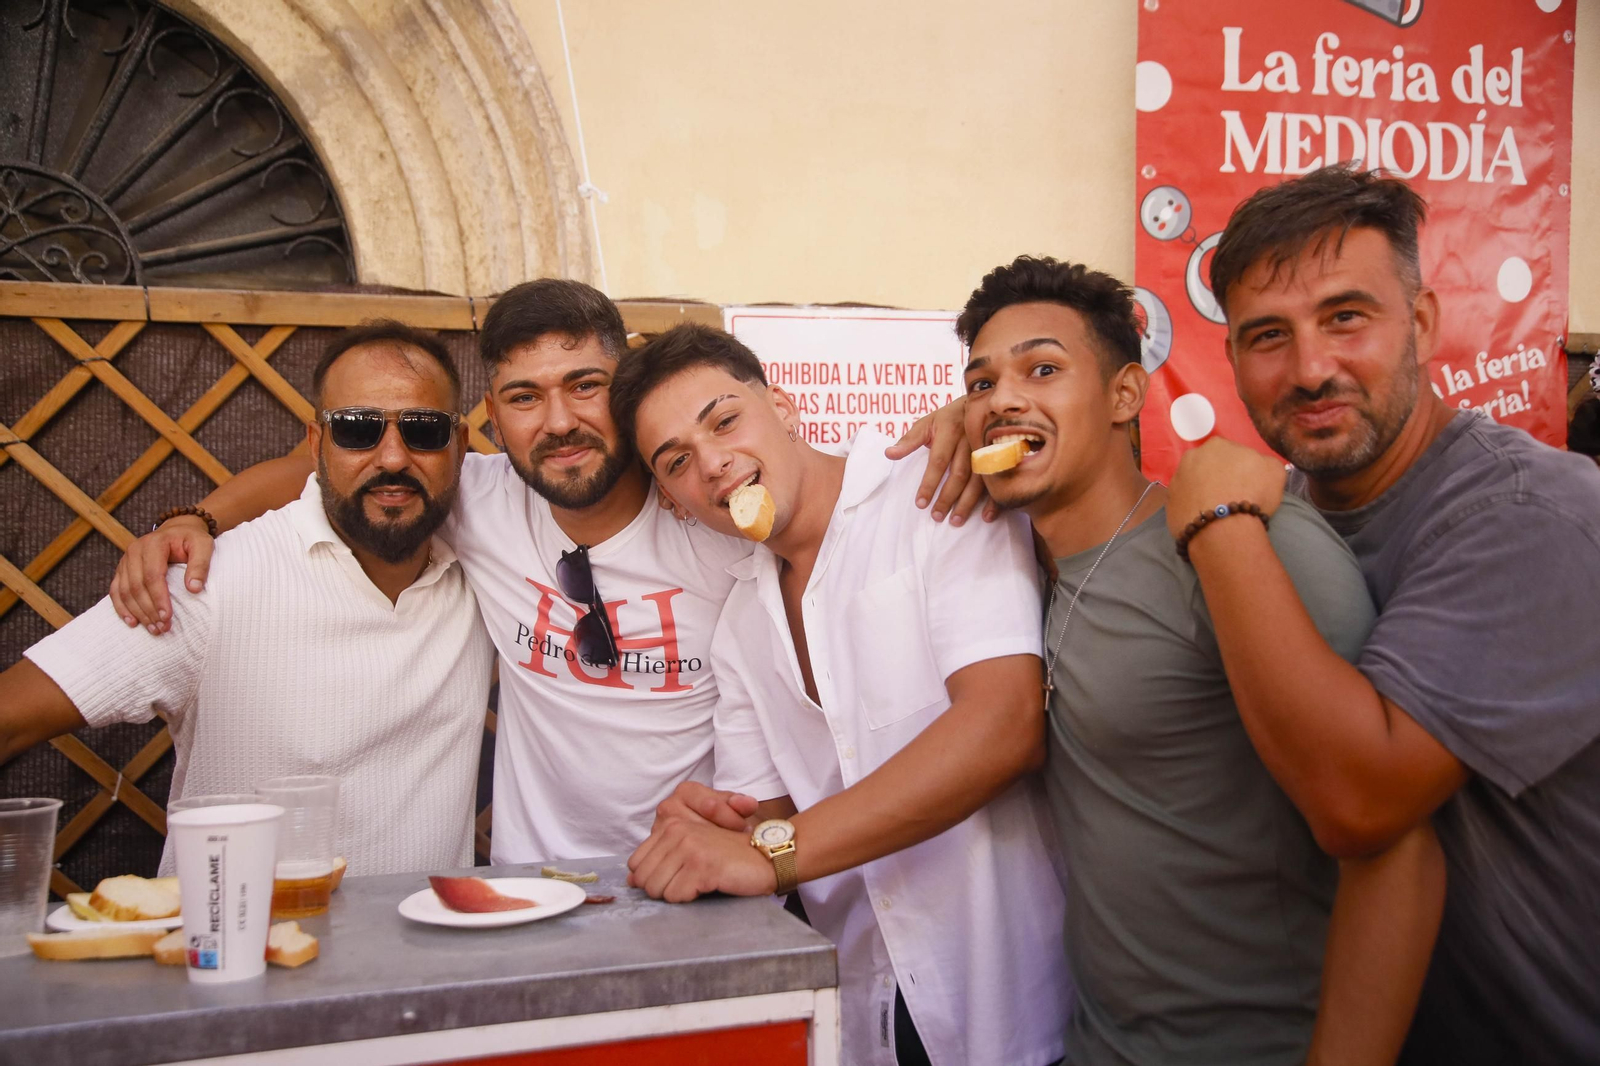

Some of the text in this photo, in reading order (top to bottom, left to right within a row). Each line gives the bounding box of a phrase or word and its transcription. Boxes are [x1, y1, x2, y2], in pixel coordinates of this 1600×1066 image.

[1222, 27, 1524, 107] La feria del
[1219, 109, 1527, 185] MEDIODÍA
[759, 362, 953, 386] OHIBIDA LA VENTA DE
[1441, 363, 1475, 396] la
[1475, 343, 1547, 384] feria
[825, 392, 939, 415] ALCOHOLICAS
[798, 422, 841, 444] ORES
[515, 620, 576, 663] Pedro
[623, 651, 702, 674] Hierro
